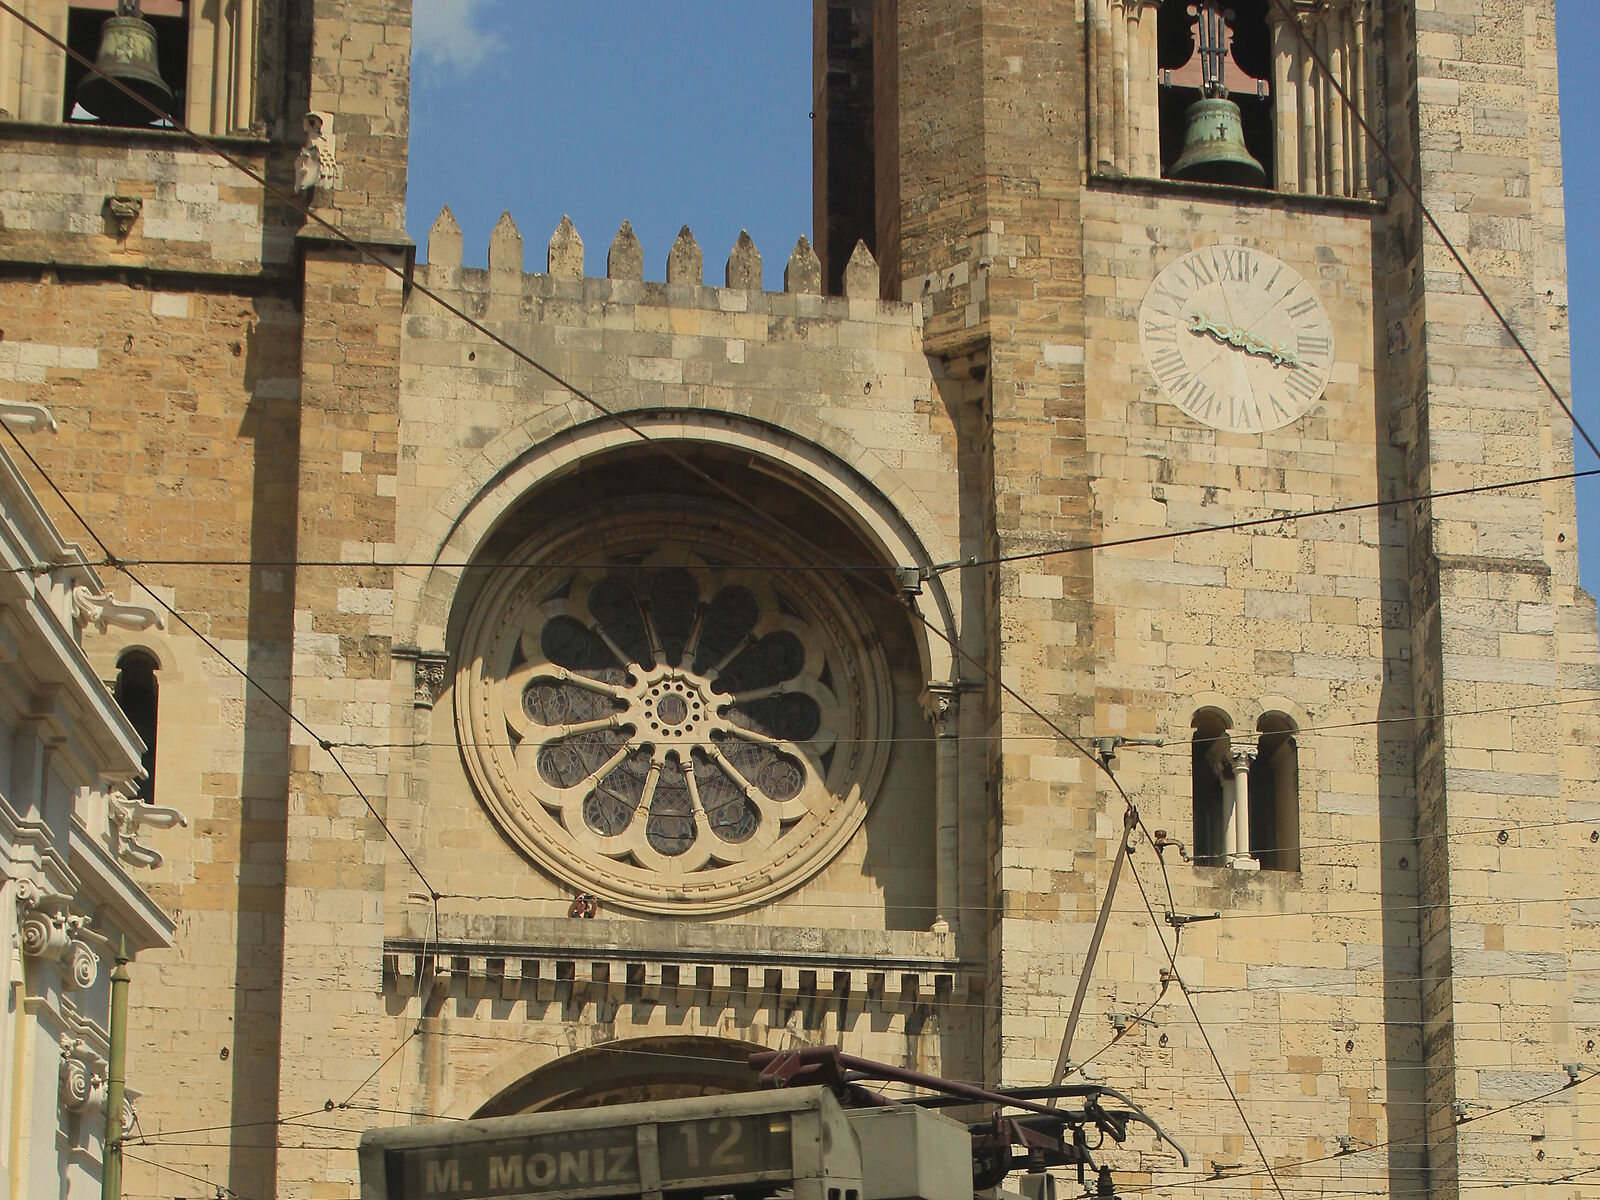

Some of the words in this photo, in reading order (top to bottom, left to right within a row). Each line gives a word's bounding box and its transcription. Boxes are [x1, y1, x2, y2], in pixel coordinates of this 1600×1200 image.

[679, 1117, 744, 1168] 12
[425, 1160, 473, 1194] M.
[488, 1146, 637, 1189] MONIZ
